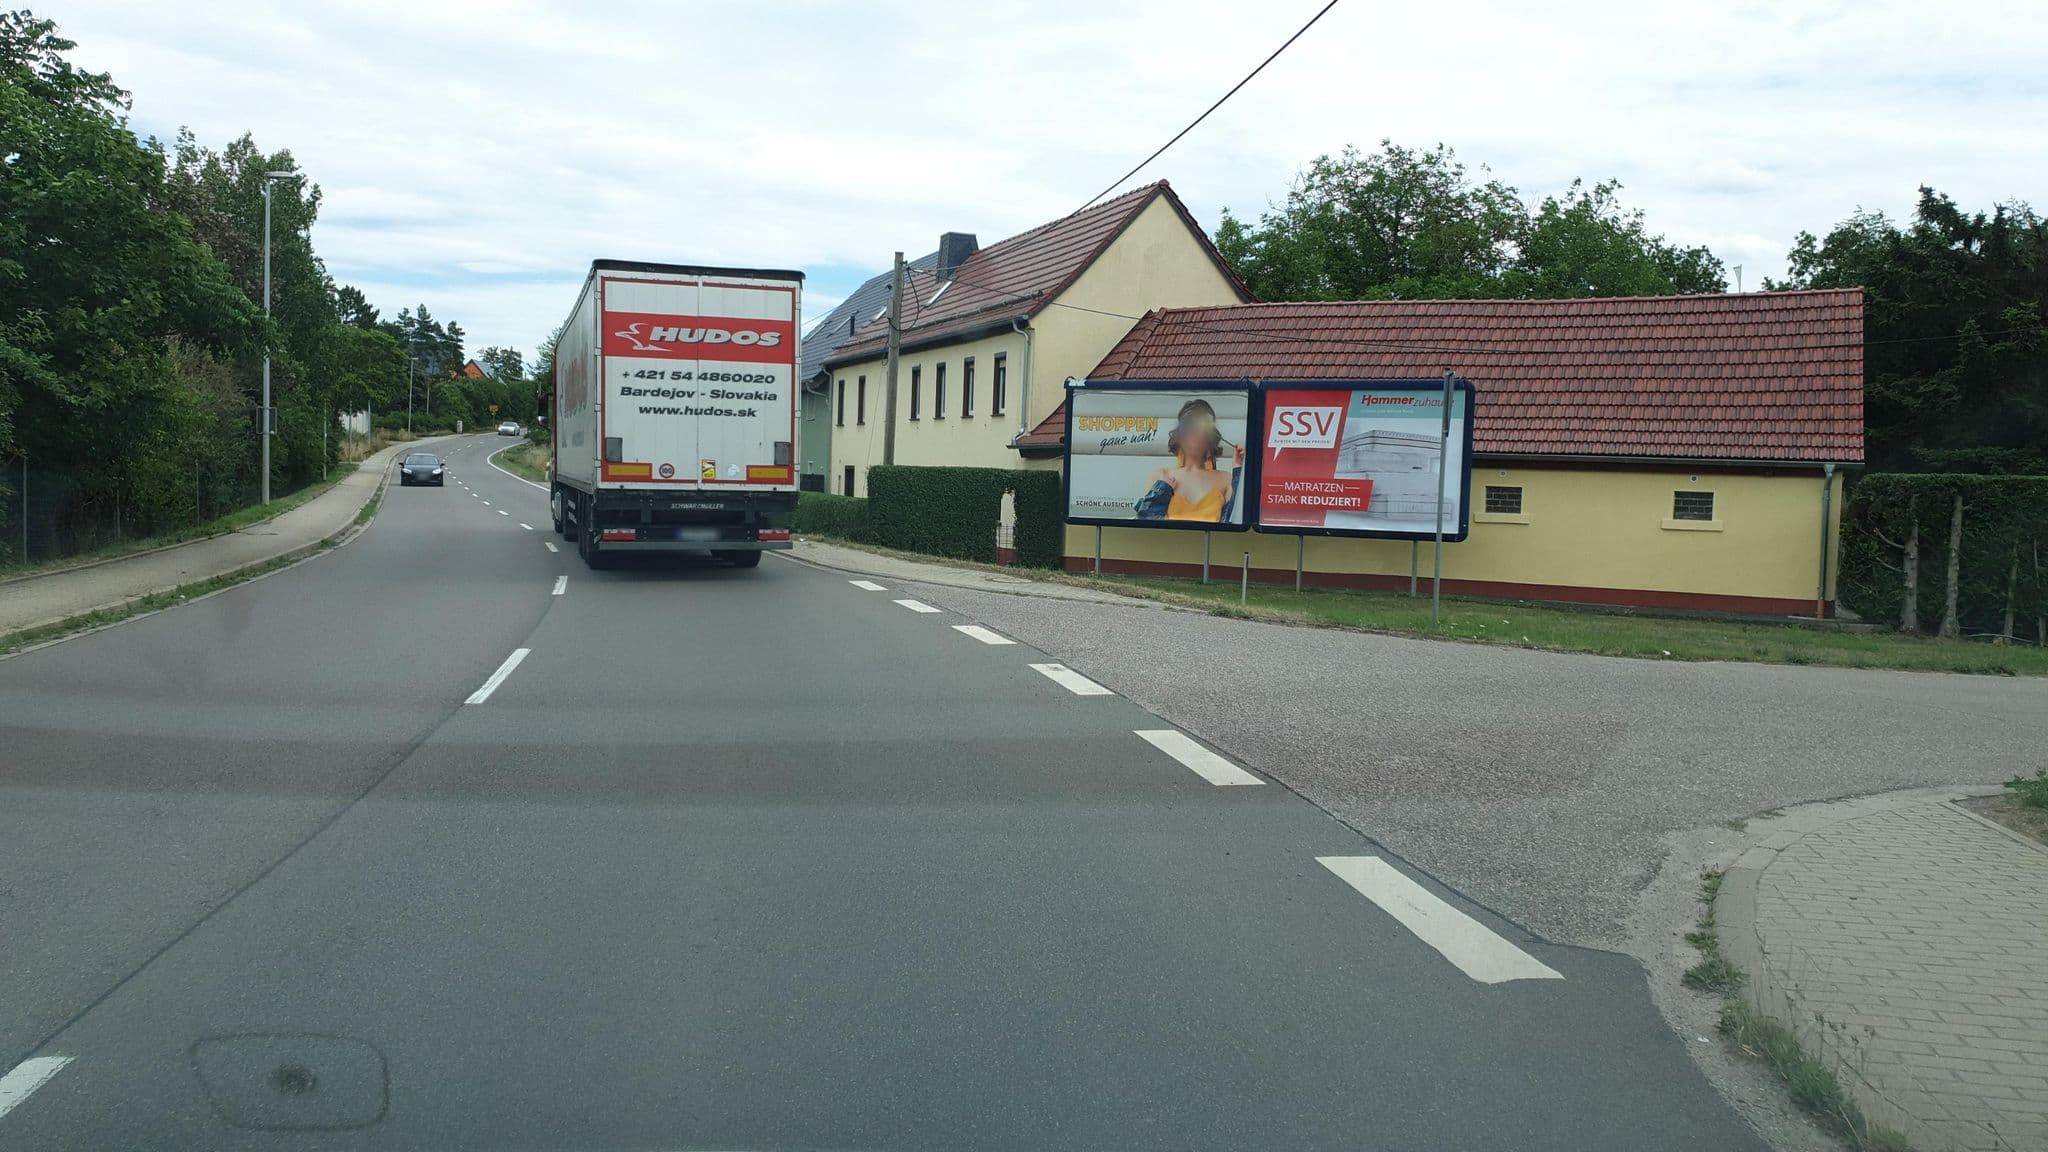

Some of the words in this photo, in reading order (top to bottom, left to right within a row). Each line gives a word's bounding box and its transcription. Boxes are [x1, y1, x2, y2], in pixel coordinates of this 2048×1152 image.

[650, 326, 782, 347] HUDOS
[670, 371, 693, 382] 54
[698, 373, 776, 385] 4860020
[620, 386, 696, 400] Bardejov
[709, 389, 778, 402] Slovakia
[638, 404, 757, 418] www.hudos.sk
[1078, 416, 1159, 432] SHOPPEN
[1277, 411, 1335, 437] SSV
[1099, 436, 1127, 454] ganz
[1284, 482, 1344, 492] MATRATZEN
[1267, 495, 1298, 504] STARK
[1300, 496, 1361, 507] REDUZIERT!
